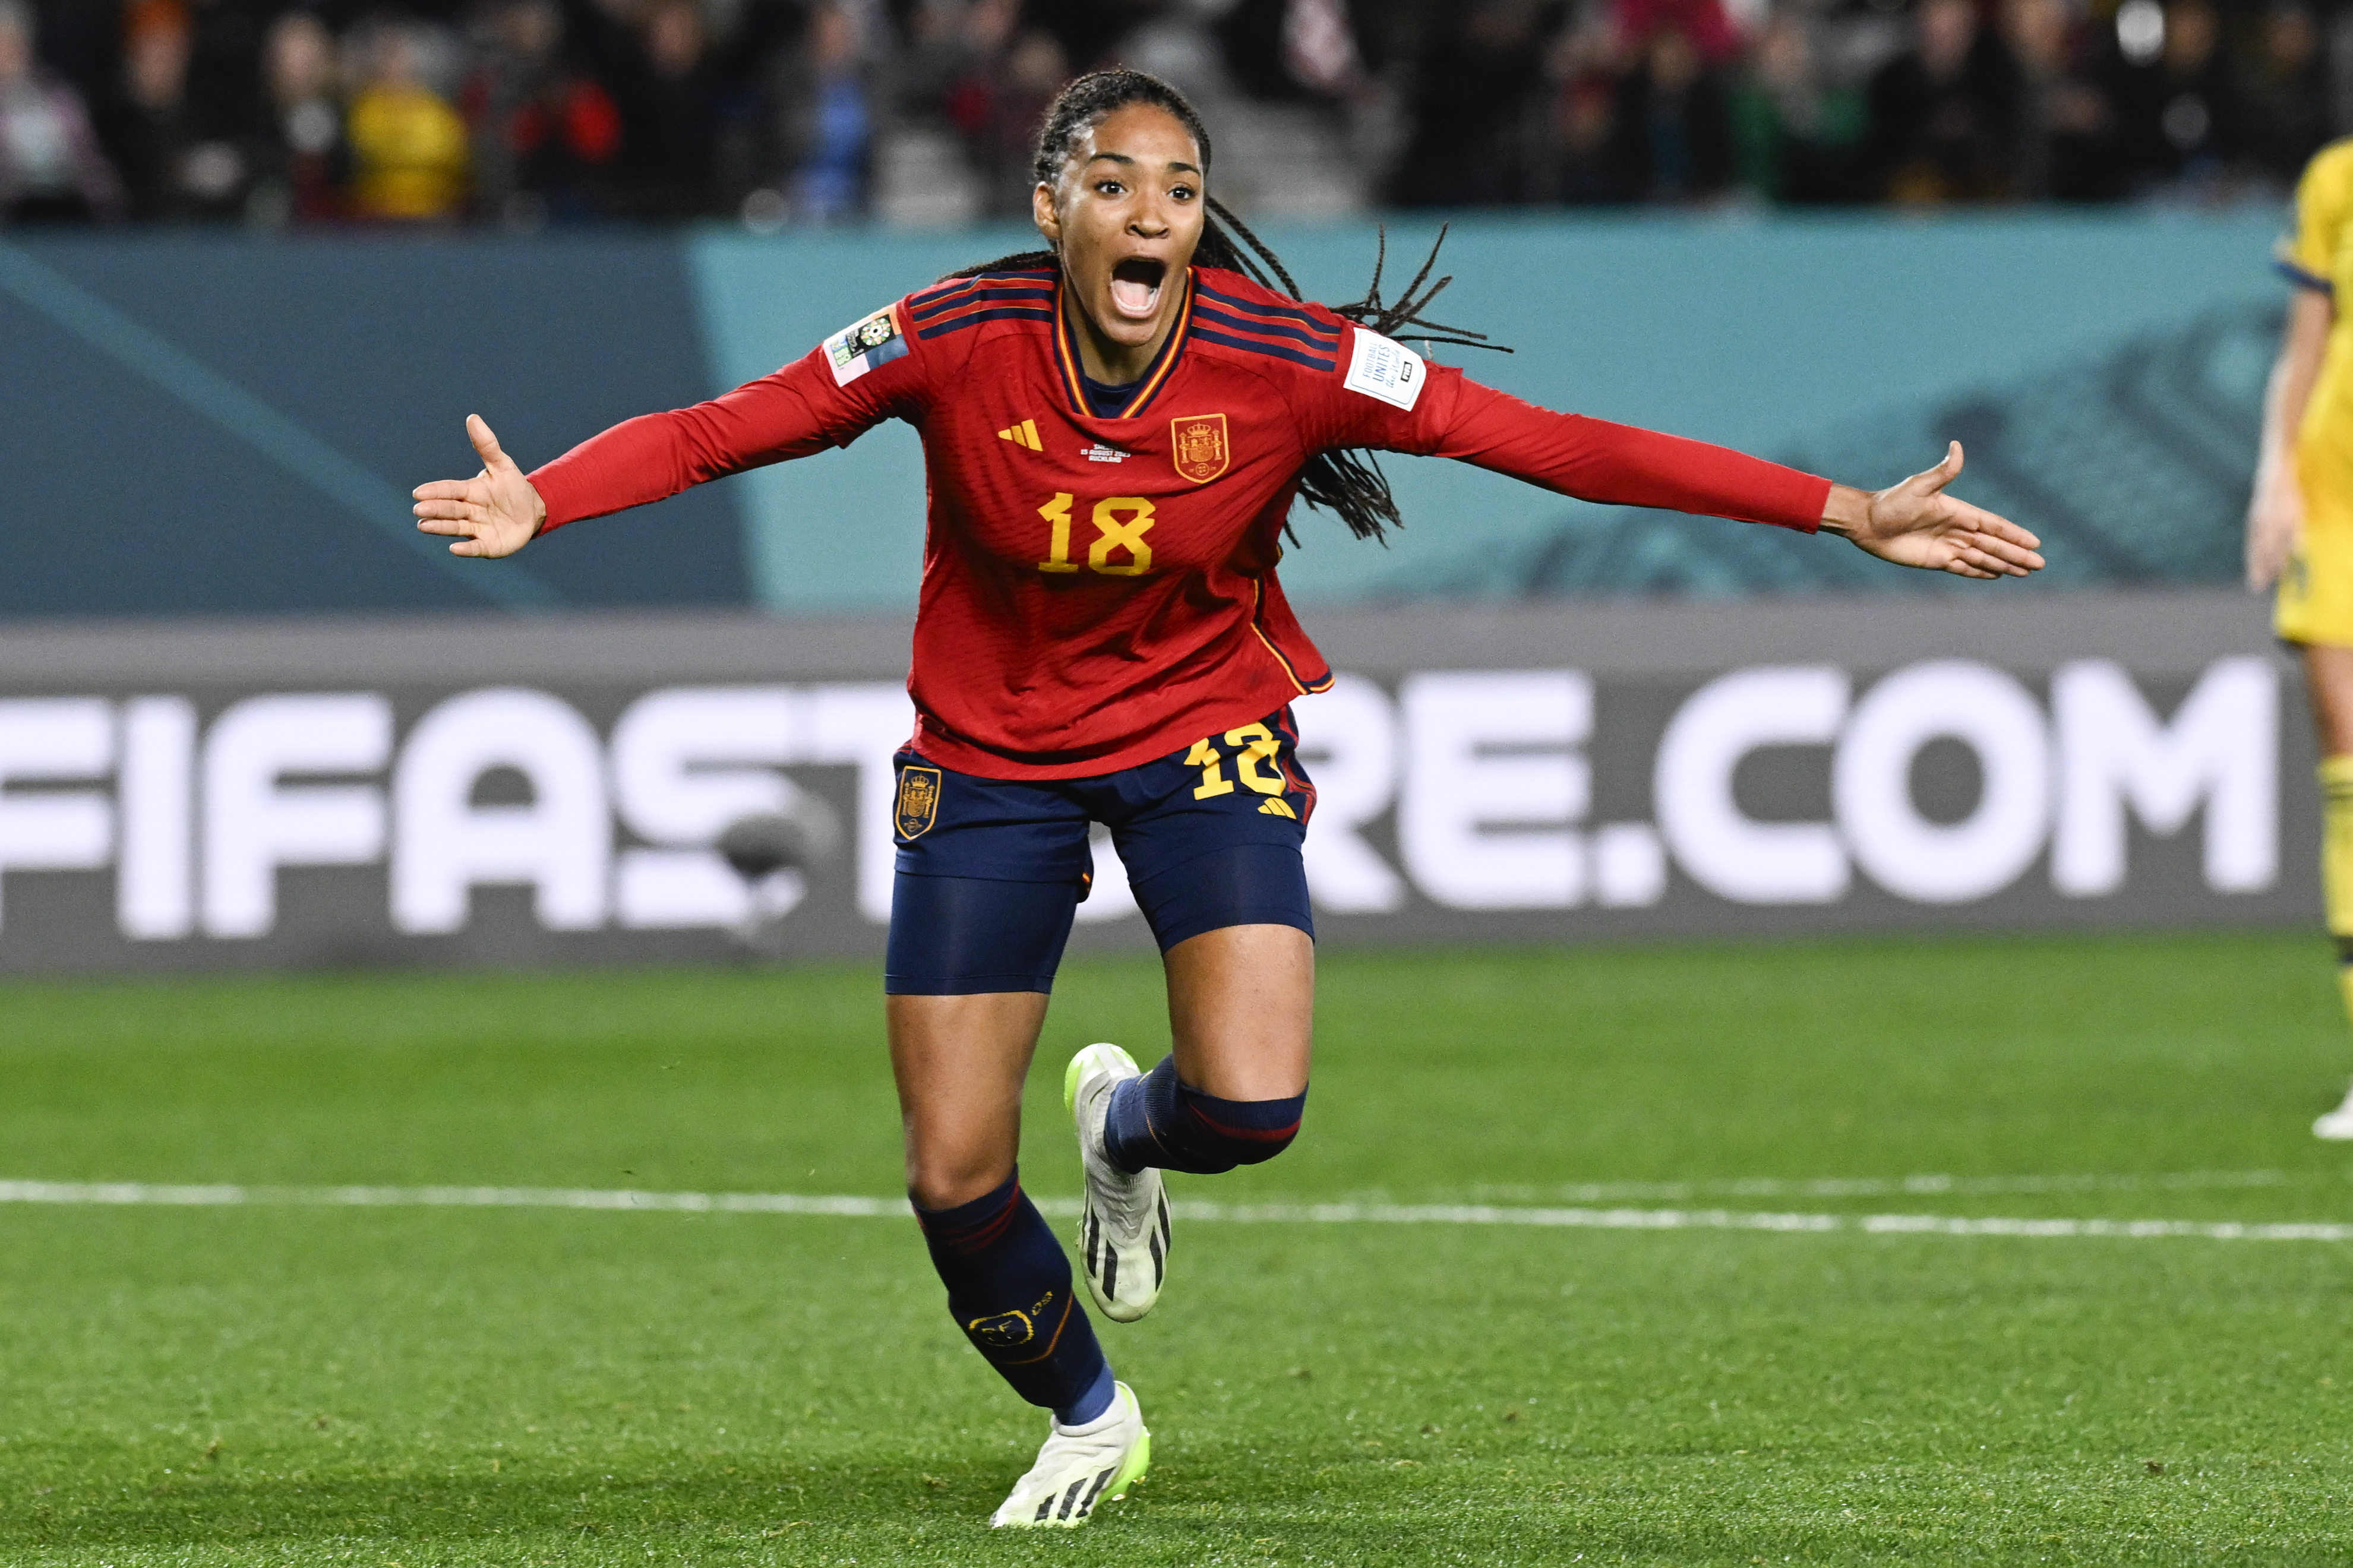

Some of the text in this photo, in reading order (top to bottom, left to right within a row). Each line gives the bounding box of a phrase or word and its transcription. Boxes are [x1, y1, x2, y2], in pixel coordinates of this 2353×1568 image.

[1363, 342, 1378, 378] FOOTBALL
[1372, 344, 1390, 382] UNITES
[1401, 363, 1411, 381] FIFA
[1037, 492, 1156, 576] 18
[0, 658, 2280, 940] FIFASTRE.COM
